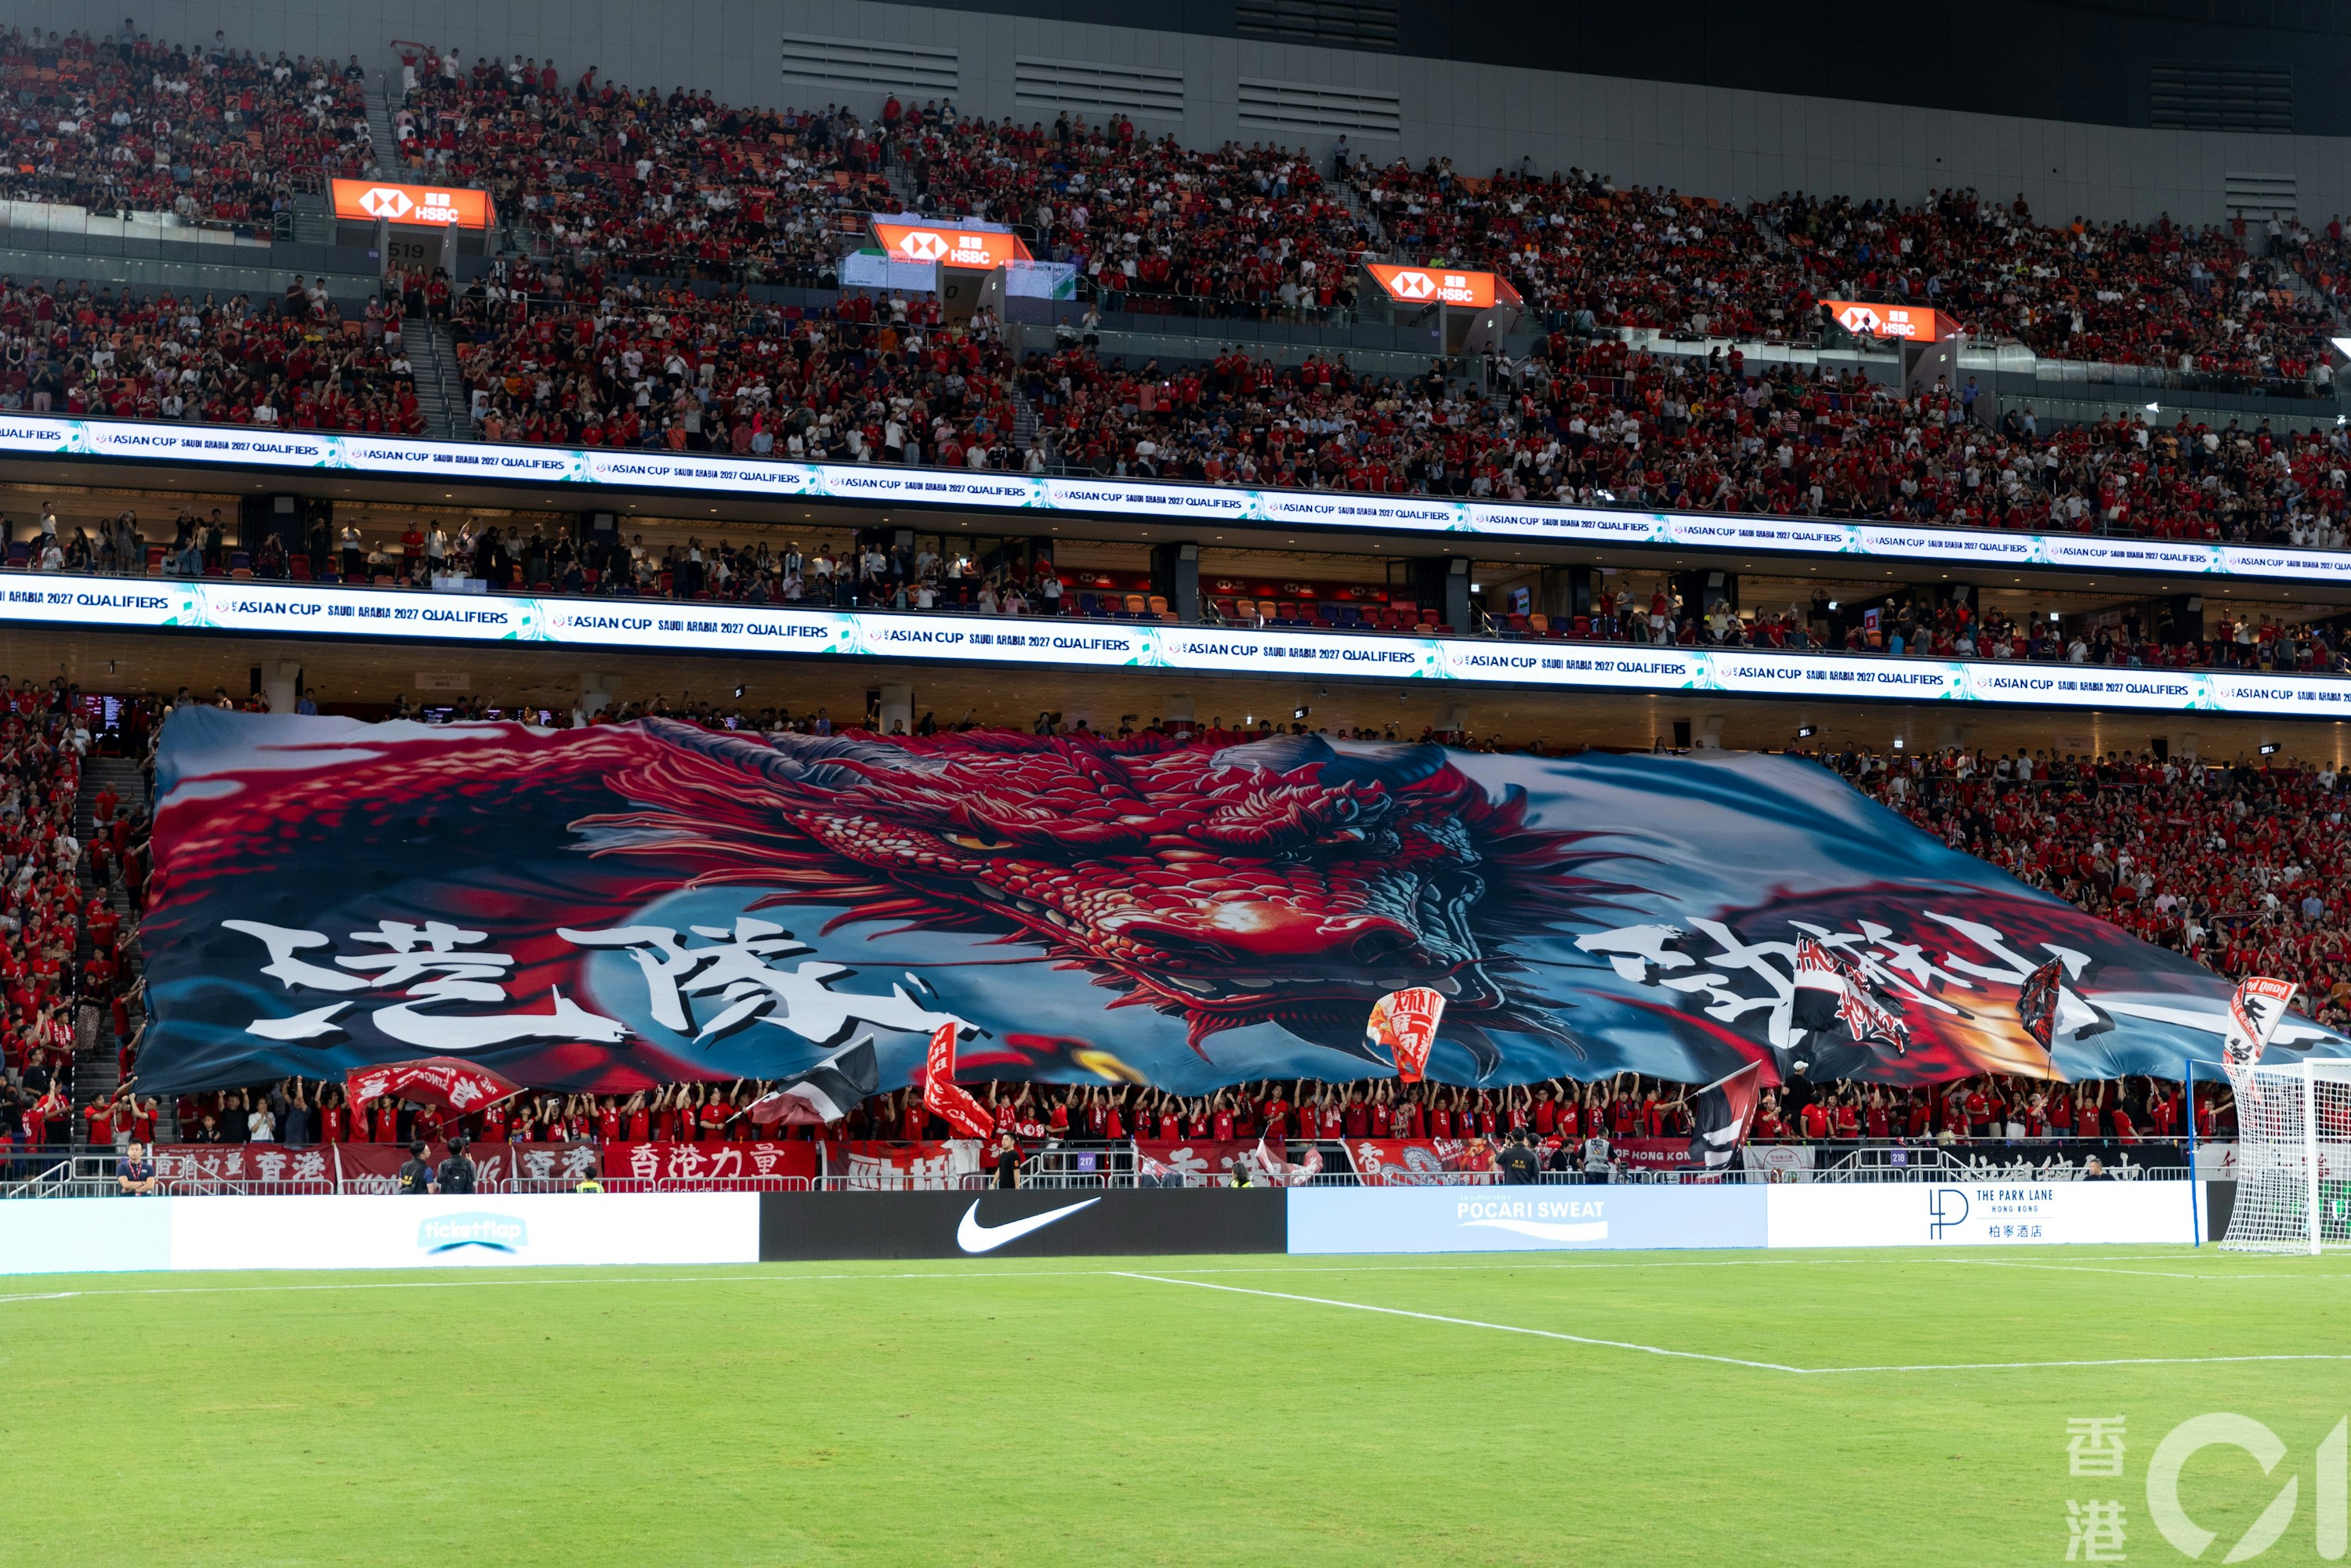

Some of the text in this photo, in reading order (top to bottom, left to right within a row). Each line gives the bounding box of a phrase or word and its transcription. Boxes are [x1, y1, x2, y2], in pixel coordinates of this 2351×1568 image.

[415, 206, 458, 223] HSBC
[388, 243, 424, 259] 519
[951, 249, 990, 264] HSBC
[1437, 288, 1473, 302] HSBC
[1882, 322, 1915, 336] HSBC
[112, 434, 319, 455] ASIAN CUP SAUDI ARABIA 2027 QUALIFIERS
[368, 449, 565, 469] ASIAN CUP SAUDI ARABIA 2027 QUALIFIERS
[610, 464, 800, 483] ASIAN CUP SAUDI ARABIA 2027 QUALIFIERS
[844, 477, 1026, 497] ASIAN CUP SAUDI ARABIA 2027 QUALIFIERS
[1068, 491, 1099, 501] ASIAN
[1100, 492, 1122, 502] CUP
[1167, 496, 1184, 505] 2027
[1185, 497, 1242, 509] QUALIFIERS
[1283, 502, 1313, 512] ASIAN
[1313, 504, 1335, 514] CUP
[1378, 508, 1394, 517] 2027
[1394, 509, 1450, 520] QUALIFIERS
[1488, 514, 1518, 524] ASIAN
[1518, 516, 1538, 526] CUP
[1581, 520, 1596, 528] 2027
[1596, 520, 1650, 531] QUALIFIERS
[9, 590, 43, 603] ARABIA
[46, 592, 73, 604] 2027
[76, 593, 168, 609] QUALIFIERS
[237, 600, 508, 624] ASIAN CUP SAUDI ARABIA 2027 QUALIFIERS
[573, 615, 828, 638] ASIAN CUP SAUDI ARABIA 2027 QUALIFIERS
[889, 629, 1129, 651] ASIAN CUP SAUDI ARABIA 2027 QUALIFIERS
[1187, 643, 1415, 663] ASIAN CUP SAUDI ARABIA 2027 QUALIFIERS
[1469, 654, 1686, 675] ASIAN CUP SAUDI ARABIA 2027 QUALIFIERS
[1737, 666, 1943, 685] ASIAN CUP SAUDI ARABIA 2027 QUALIFIERS
[1993, 677, 2189, 695] ASIAN CUP SAUDI ARABIA 2027 QUALIFIERS
[2235, 687, 2341, 701] ASIAN CUP SAUDI ARABIA
[523, 1145, 596, 1180] 香港
[629, 1143, 785, 1182] 香港力量
[1079, 1157, 1093, 1166] 217
[1357, 1142, 1385, 1173] 香
[1632, 1150, 1665, 1161] HONG
[1666, 1151, 1691, 1161] KON
[1893, 1153, 1905, 1162] 218
[255, 1150, 327, 1181] 香港
[1976, 1189, 2053, 1201] THE PARK LANE
[1457, 1200, 1605, 1219] POCARI SWEAT
[1991, 1204, 2038, 1213] HONG KONG
[424, 1220, 523, 1242] ticketflap
[1988, 1224, 2043, 1238] 柏寧酒店
